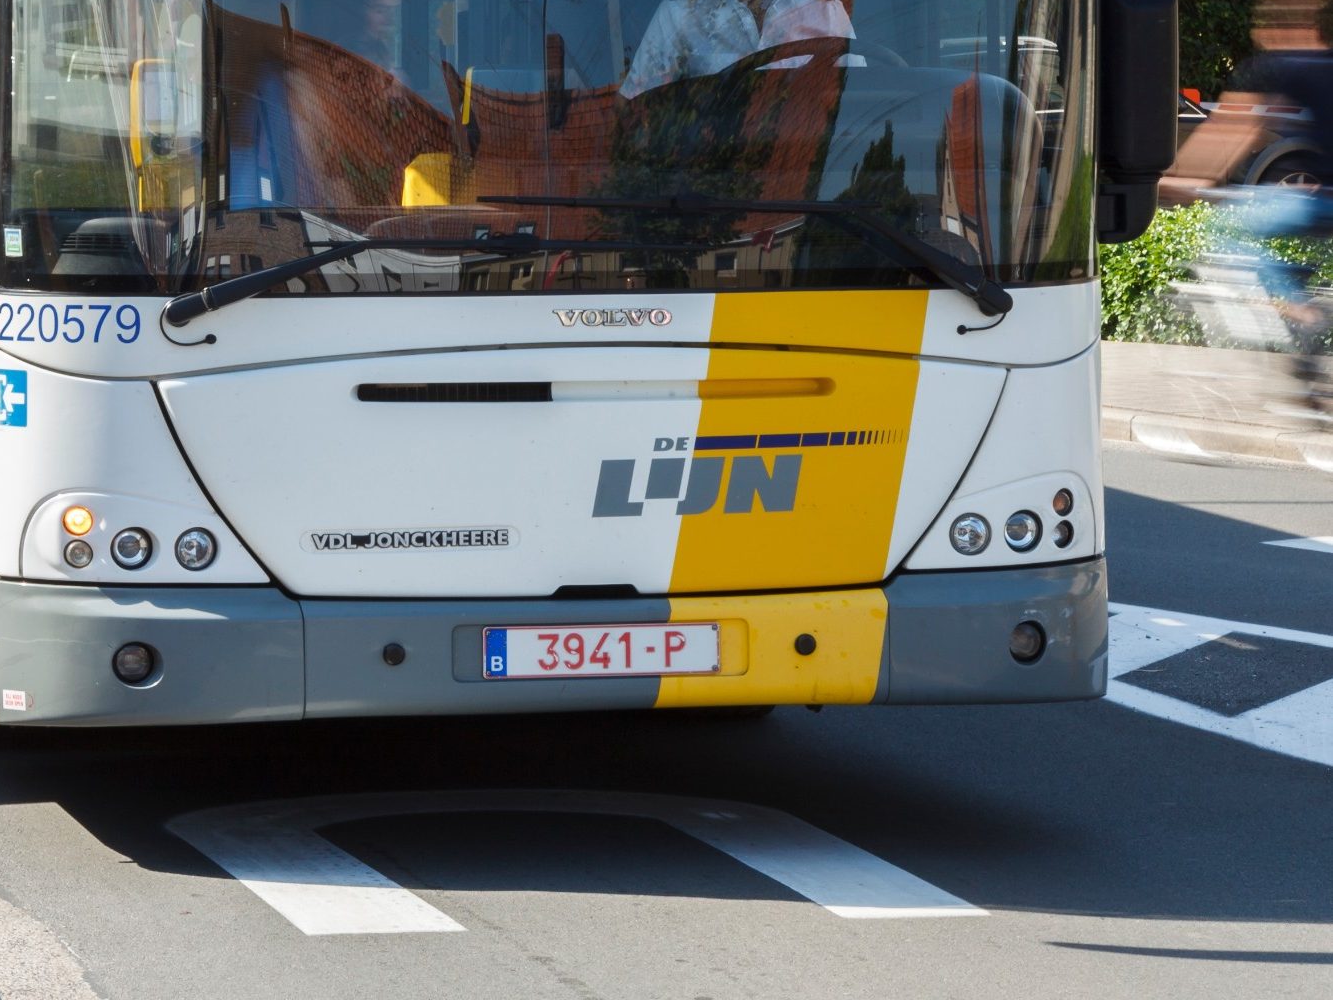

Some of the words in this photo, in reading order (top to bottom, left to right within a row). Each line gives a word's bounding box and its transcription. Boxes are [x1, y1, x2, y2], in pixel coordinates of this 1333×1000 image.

[553, 308, 673, 327] VOLVO
[653, 437, 690, 452] DE
[592, 454, 804, 518] LIJN
[312, 534, 357, 550] VDL
[364, 529, 508, 549] JONCKHEERE
[537, 631, 686, 670] 3941-P
[490, 656, 504, 672] B
